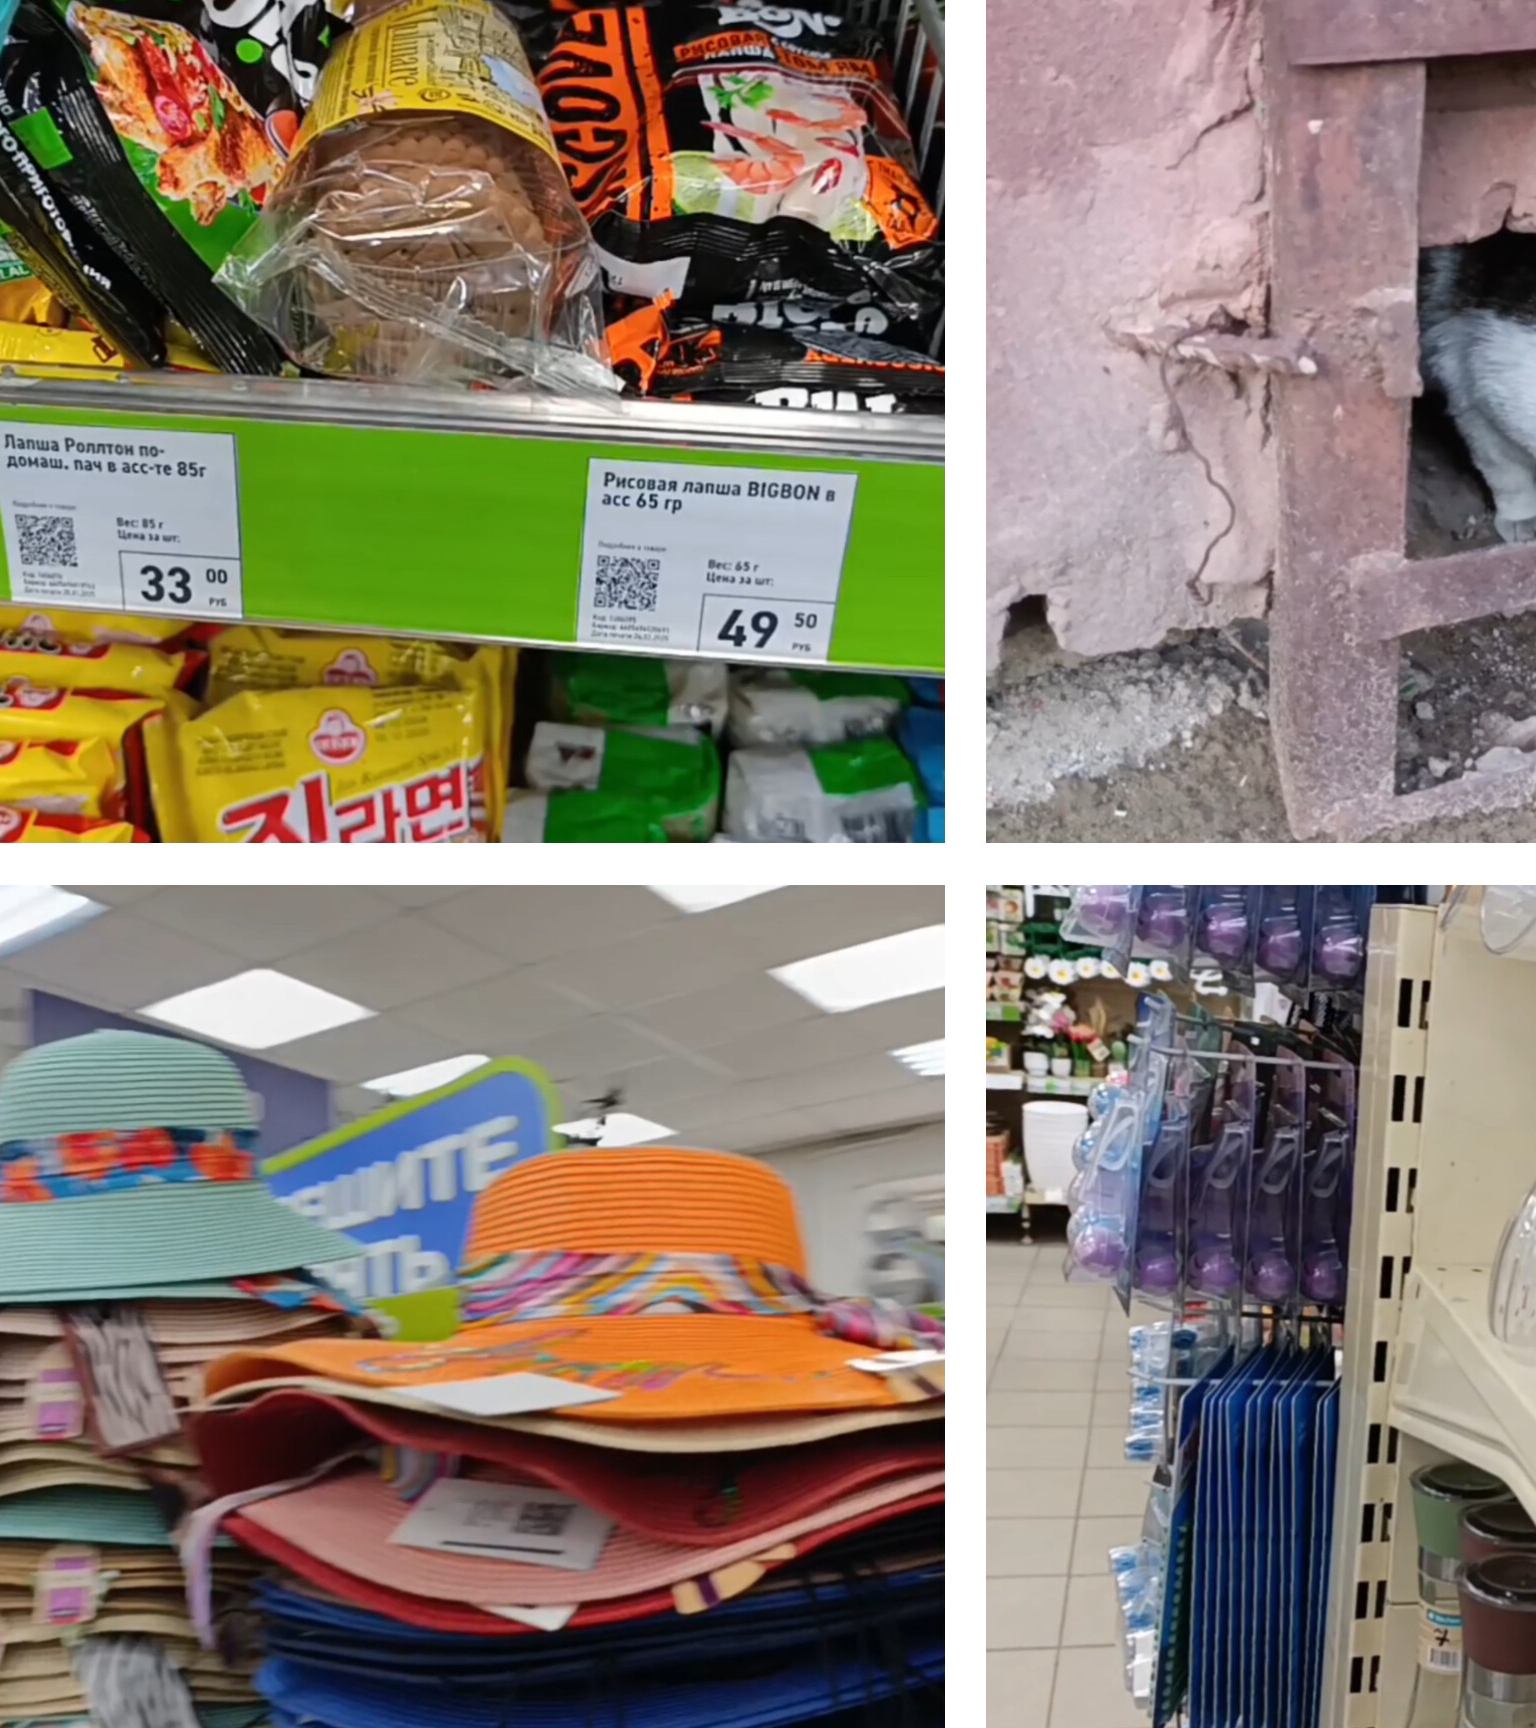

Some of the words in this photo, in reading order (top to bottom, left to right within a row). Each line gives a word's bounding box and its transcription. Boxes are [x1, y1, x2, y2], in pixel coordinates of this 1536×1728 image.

[4, 433, 60, 452] Лапша
[65, 437, 134, 456] Роллтон
[139, 445, 165, 458] по-
[7, 455, 69, 470] домаш.
[74, 459, 103, 473] пач
[108, 462, 117, 473] в
[121, 462, 172, 476] асс-те
[177, 461, 207, 477] 85г
[603, 472, 678, 492] Рисовая
[682, 480, 741, 496] лапша
[747, 481, 820, 502] BIGBON
[826, 489, 836, 502] в
[602, 493, 630, 507] асс
[636, 492, 659, 510] 65
[664, 497, 683, 514] гр
[116, 517, 139, 528] Вес:
[117, 530, 146, 542] Цена
[708, 559, 732, 573] Вес:
[735, 560, 751, 573] 65
[140, 564, 193, 605] 33
[206, 568, 229, 585] 00
[706, 572, 736, 587] Цена
[739, 575, 752, 586] за
[209, 597, 228, 608] РУБ
[717, 608, 779, 649] 49
[794, 612, 818, 630] 50
[792, 641, 812, 652] РУБ
[276, 1115, 520, 1230] ЕШИТЕ
